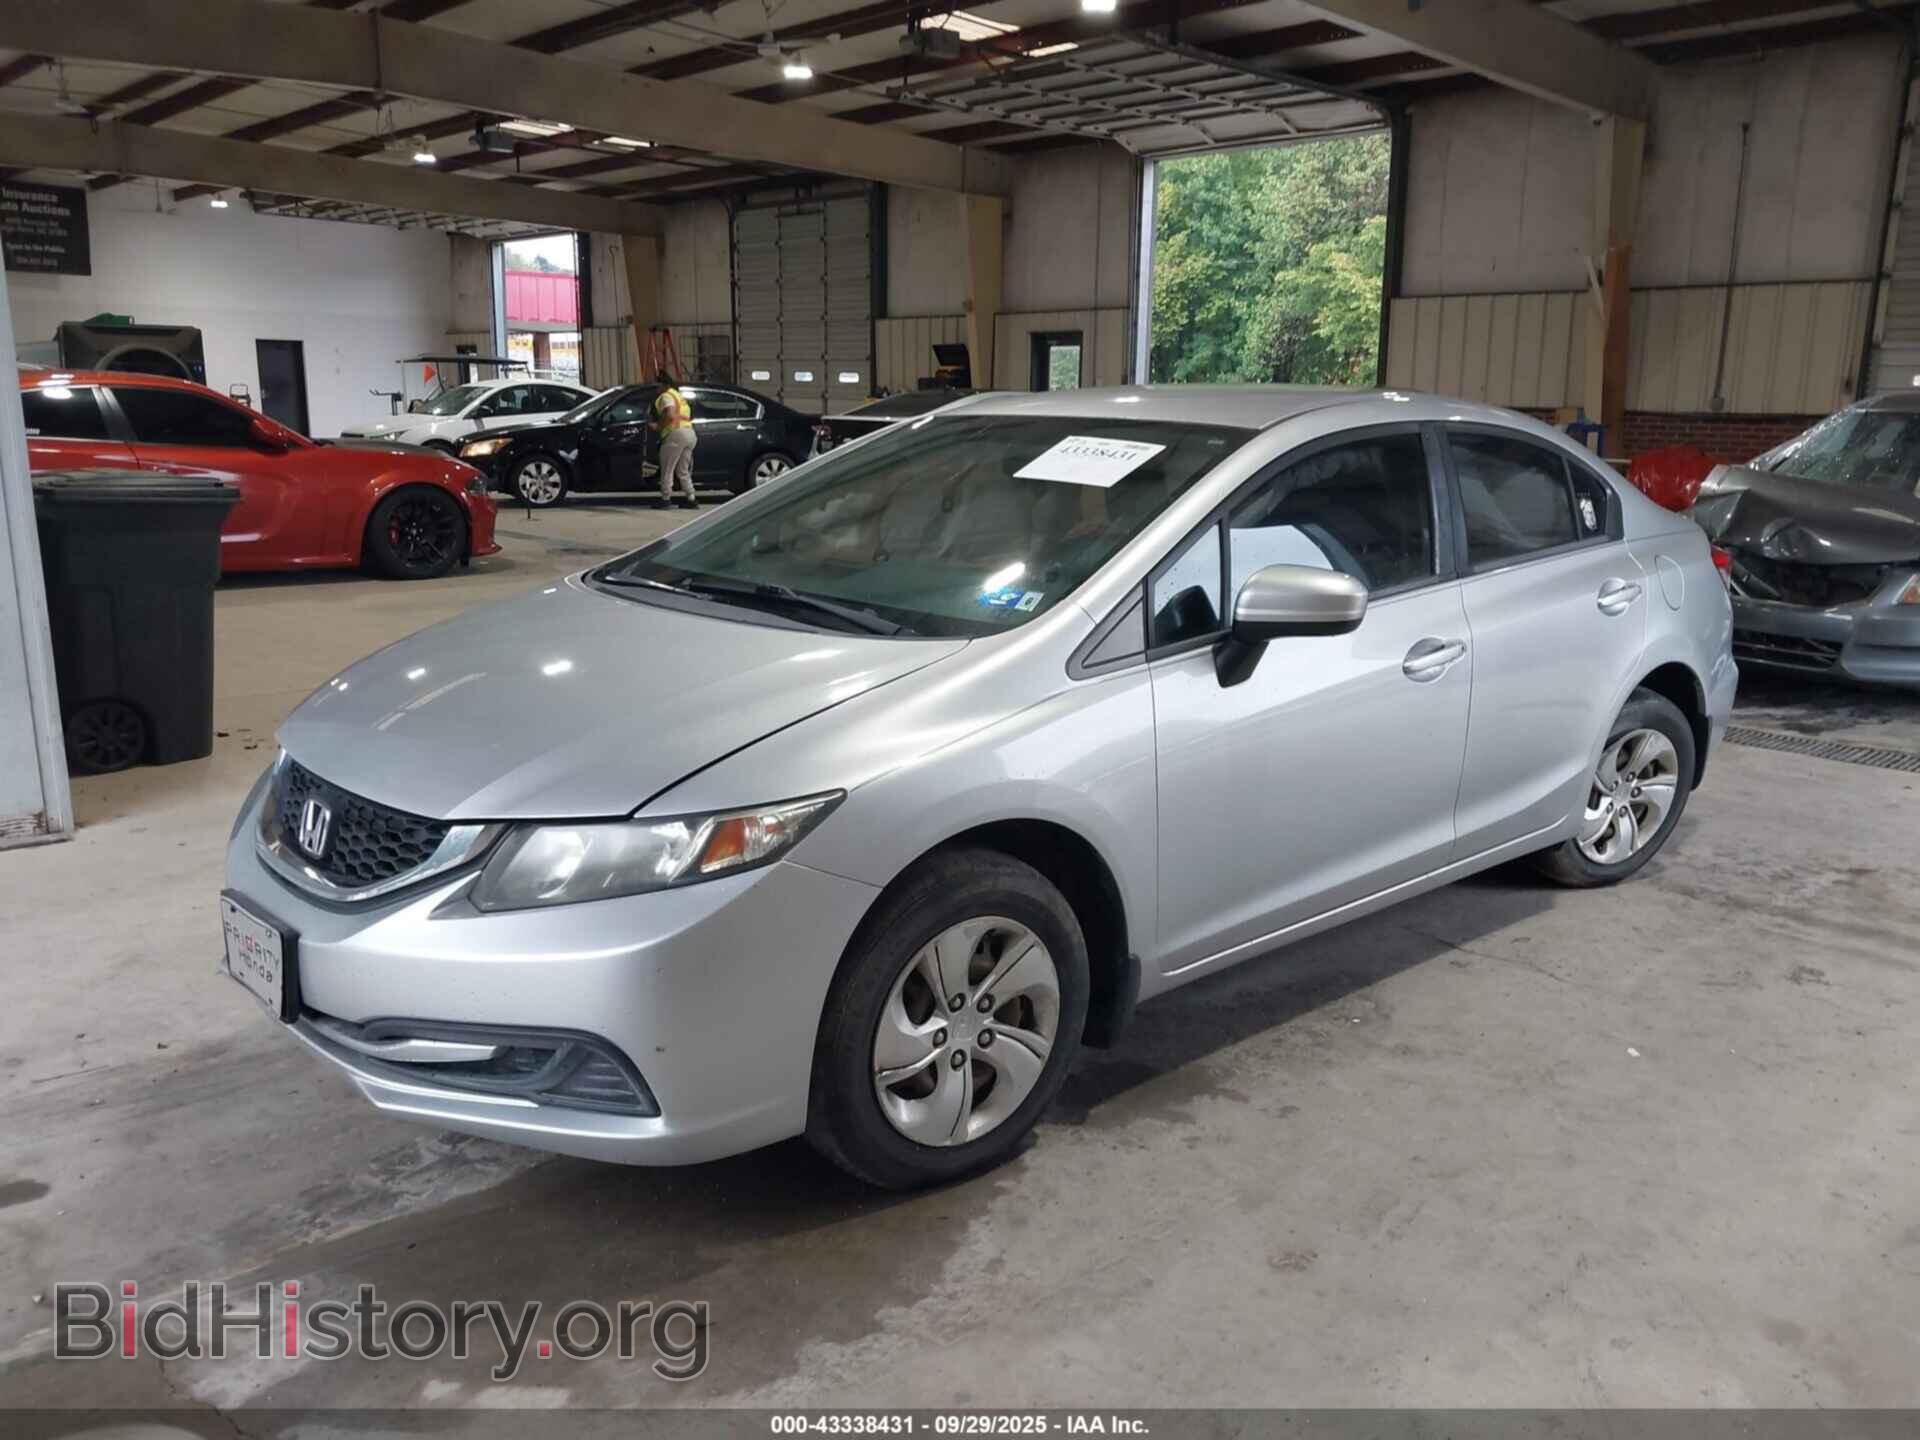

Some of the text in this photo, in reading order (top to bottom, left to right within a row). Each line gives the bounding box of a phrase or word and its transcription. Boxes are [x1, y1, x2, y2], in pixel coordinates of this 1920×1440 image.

[2, 187, 59, 202] Insurance
[22, 202, 71, 216] Auctions
[225, 921, 280, 971] PRIORITY
